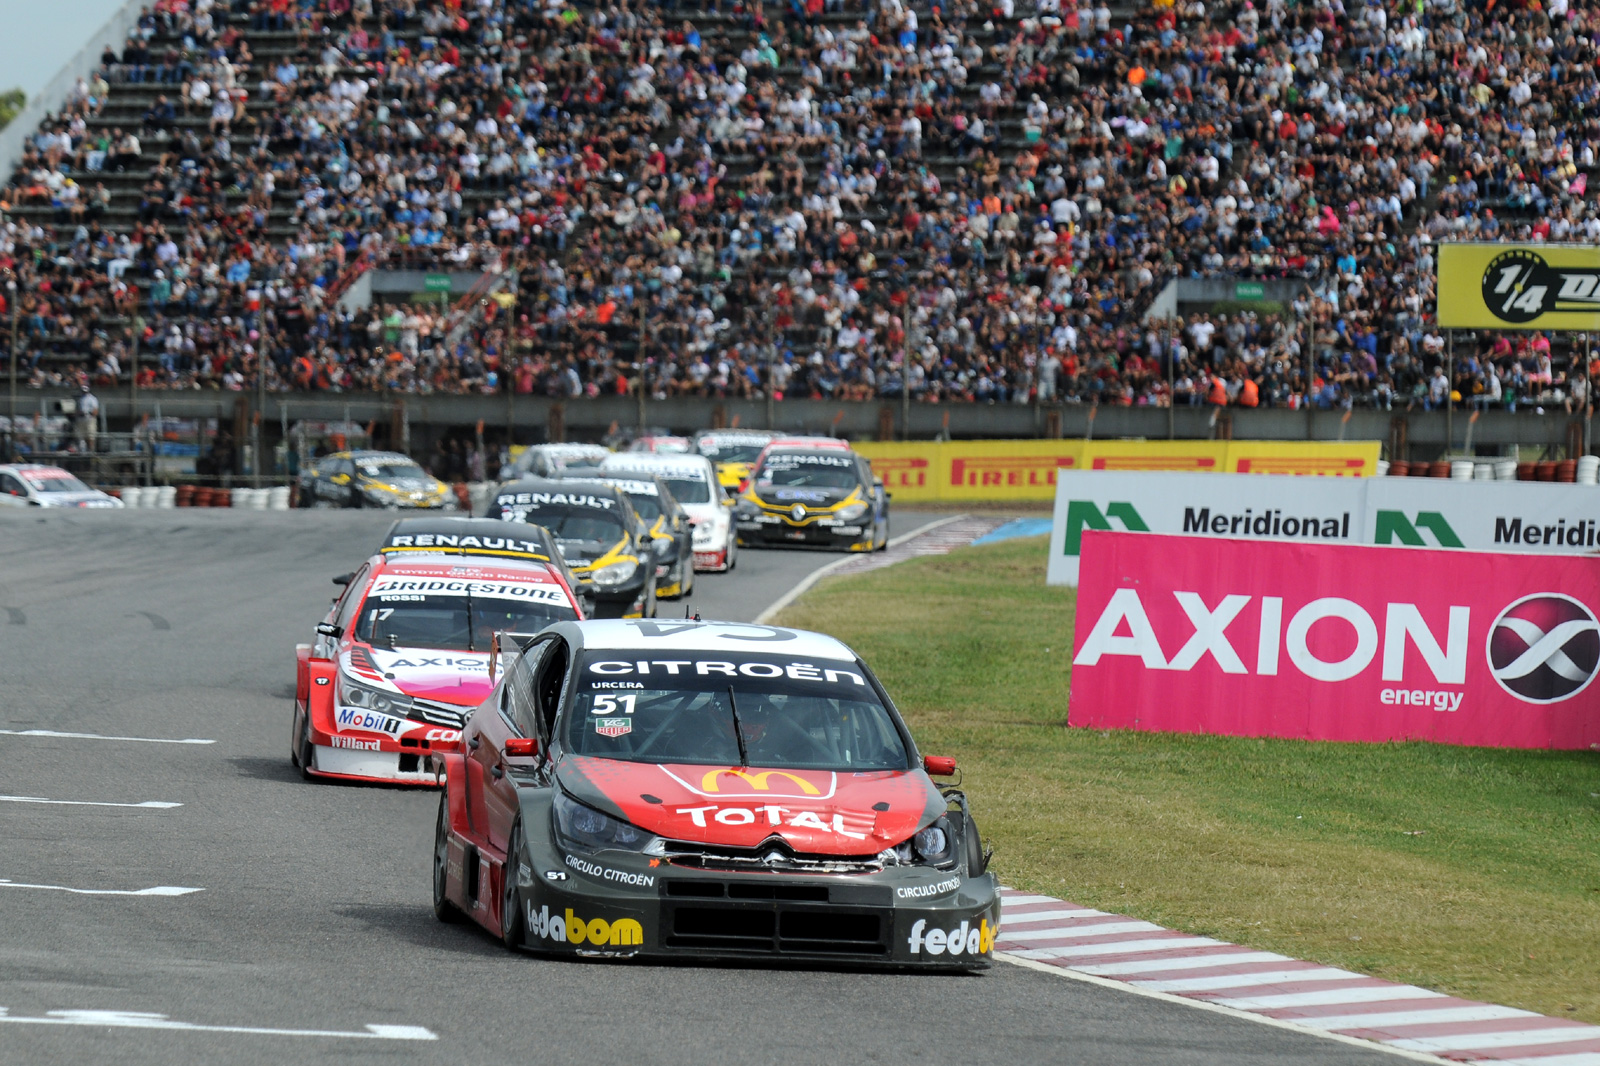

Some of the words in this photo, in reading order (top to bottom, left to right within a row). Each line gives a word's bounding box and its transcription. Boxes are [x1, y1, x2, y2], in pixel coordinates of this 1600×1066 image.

[768, 455, 853, 467] RENAULT
[497, 492, 616, 509] RENAULT
[1183, 507, 1349, 538] Meridional
[1494, 516, 1600, 547] Meridi
[391, 534, 542, 553] RENAULT
[376, 580, 563, 600] BRIDGESTONE
[380, 594, 426, 602] ROSSI
[368, 608, 395, 622] 17
[1073, 587, 1471, 684] AXION
[590, 694, 637, 714] 51
[1380, 688, 1464, 712] energy
[338, 708, 386, 731] Mobil
[385, 719, 399, 734] 1
[602, 719, 626, 727] TAG
[331, 736, 381, 751] Willard
[676, 804, 866, 840] TOTAL
[547, 871, 566, 880] 51
[565, 854, 603, 877] CIRCULO
[603, 868, 655, 887] CITROËN
[897, 884, 937, 898] CIRCULO
[527, 898, 643, 946] fedabom
